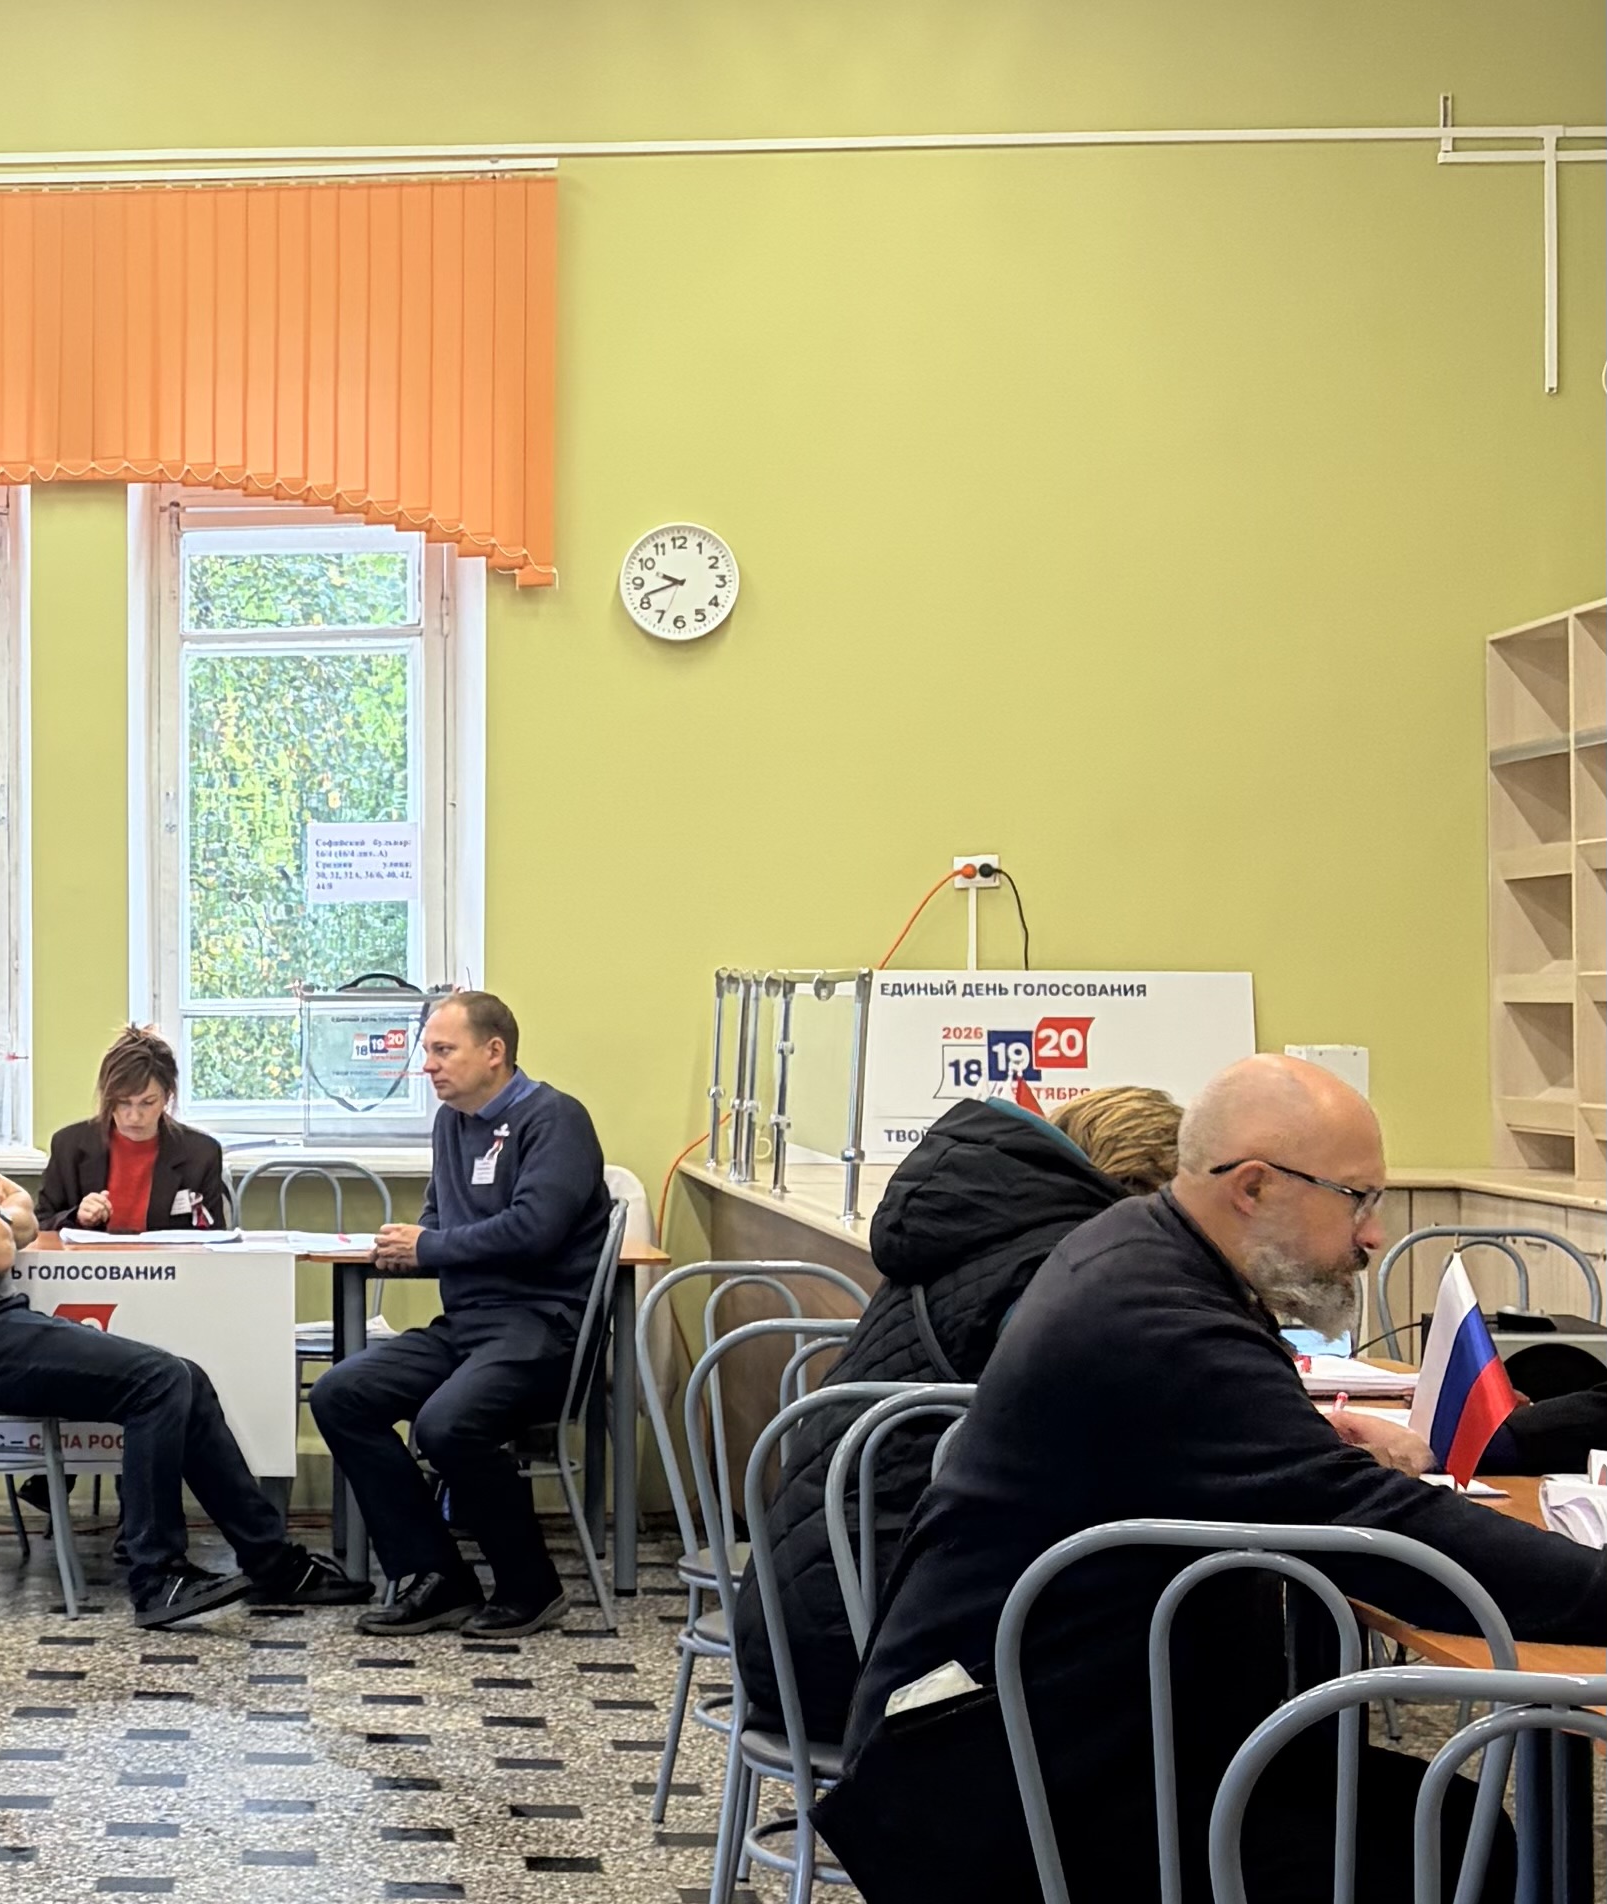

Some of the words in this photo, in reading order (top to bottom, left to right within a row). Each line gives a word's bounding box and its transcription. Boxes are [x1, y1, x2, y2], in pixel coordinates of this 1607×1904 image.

[653, 542, 666, 556] 11
[671, 535, 688, 550] 12
[696, 541, 703, 555] 1
[638, 557, 656, 571] 10
[707, 555, 719, 569] 2
[632, 576, 645, 590] 9
[715, 574, 727, 588] 3
[639, 596, 652, 610] 8
[708, 595, 720, 608] 4
[655, 609, 666, 624] 7
[673, 615, 686, 629] 6
[694, 608, 707, 622] 5
[880, 980, 957, 998] ЕДИНЫЙ
[962, 982, 1009, 998] ДЕНЬ
[1014, 983, 1147, 997] ГОЛОСОВАНИЯ
[942, 1027, 983, 1039] 2026
[355, 1045, 368, 1056] 18
[371, 1038, 385, 1051] 19
[387, 1033, 404, 1046] 20
[948, 1058, 982, 1087] 18
[992, 1042, 1030, 1072] 19
[1037, 1028, 1084, 1058] 20
[28, 1265, 176, 1280] ГОЛОСОВАНИЯ
